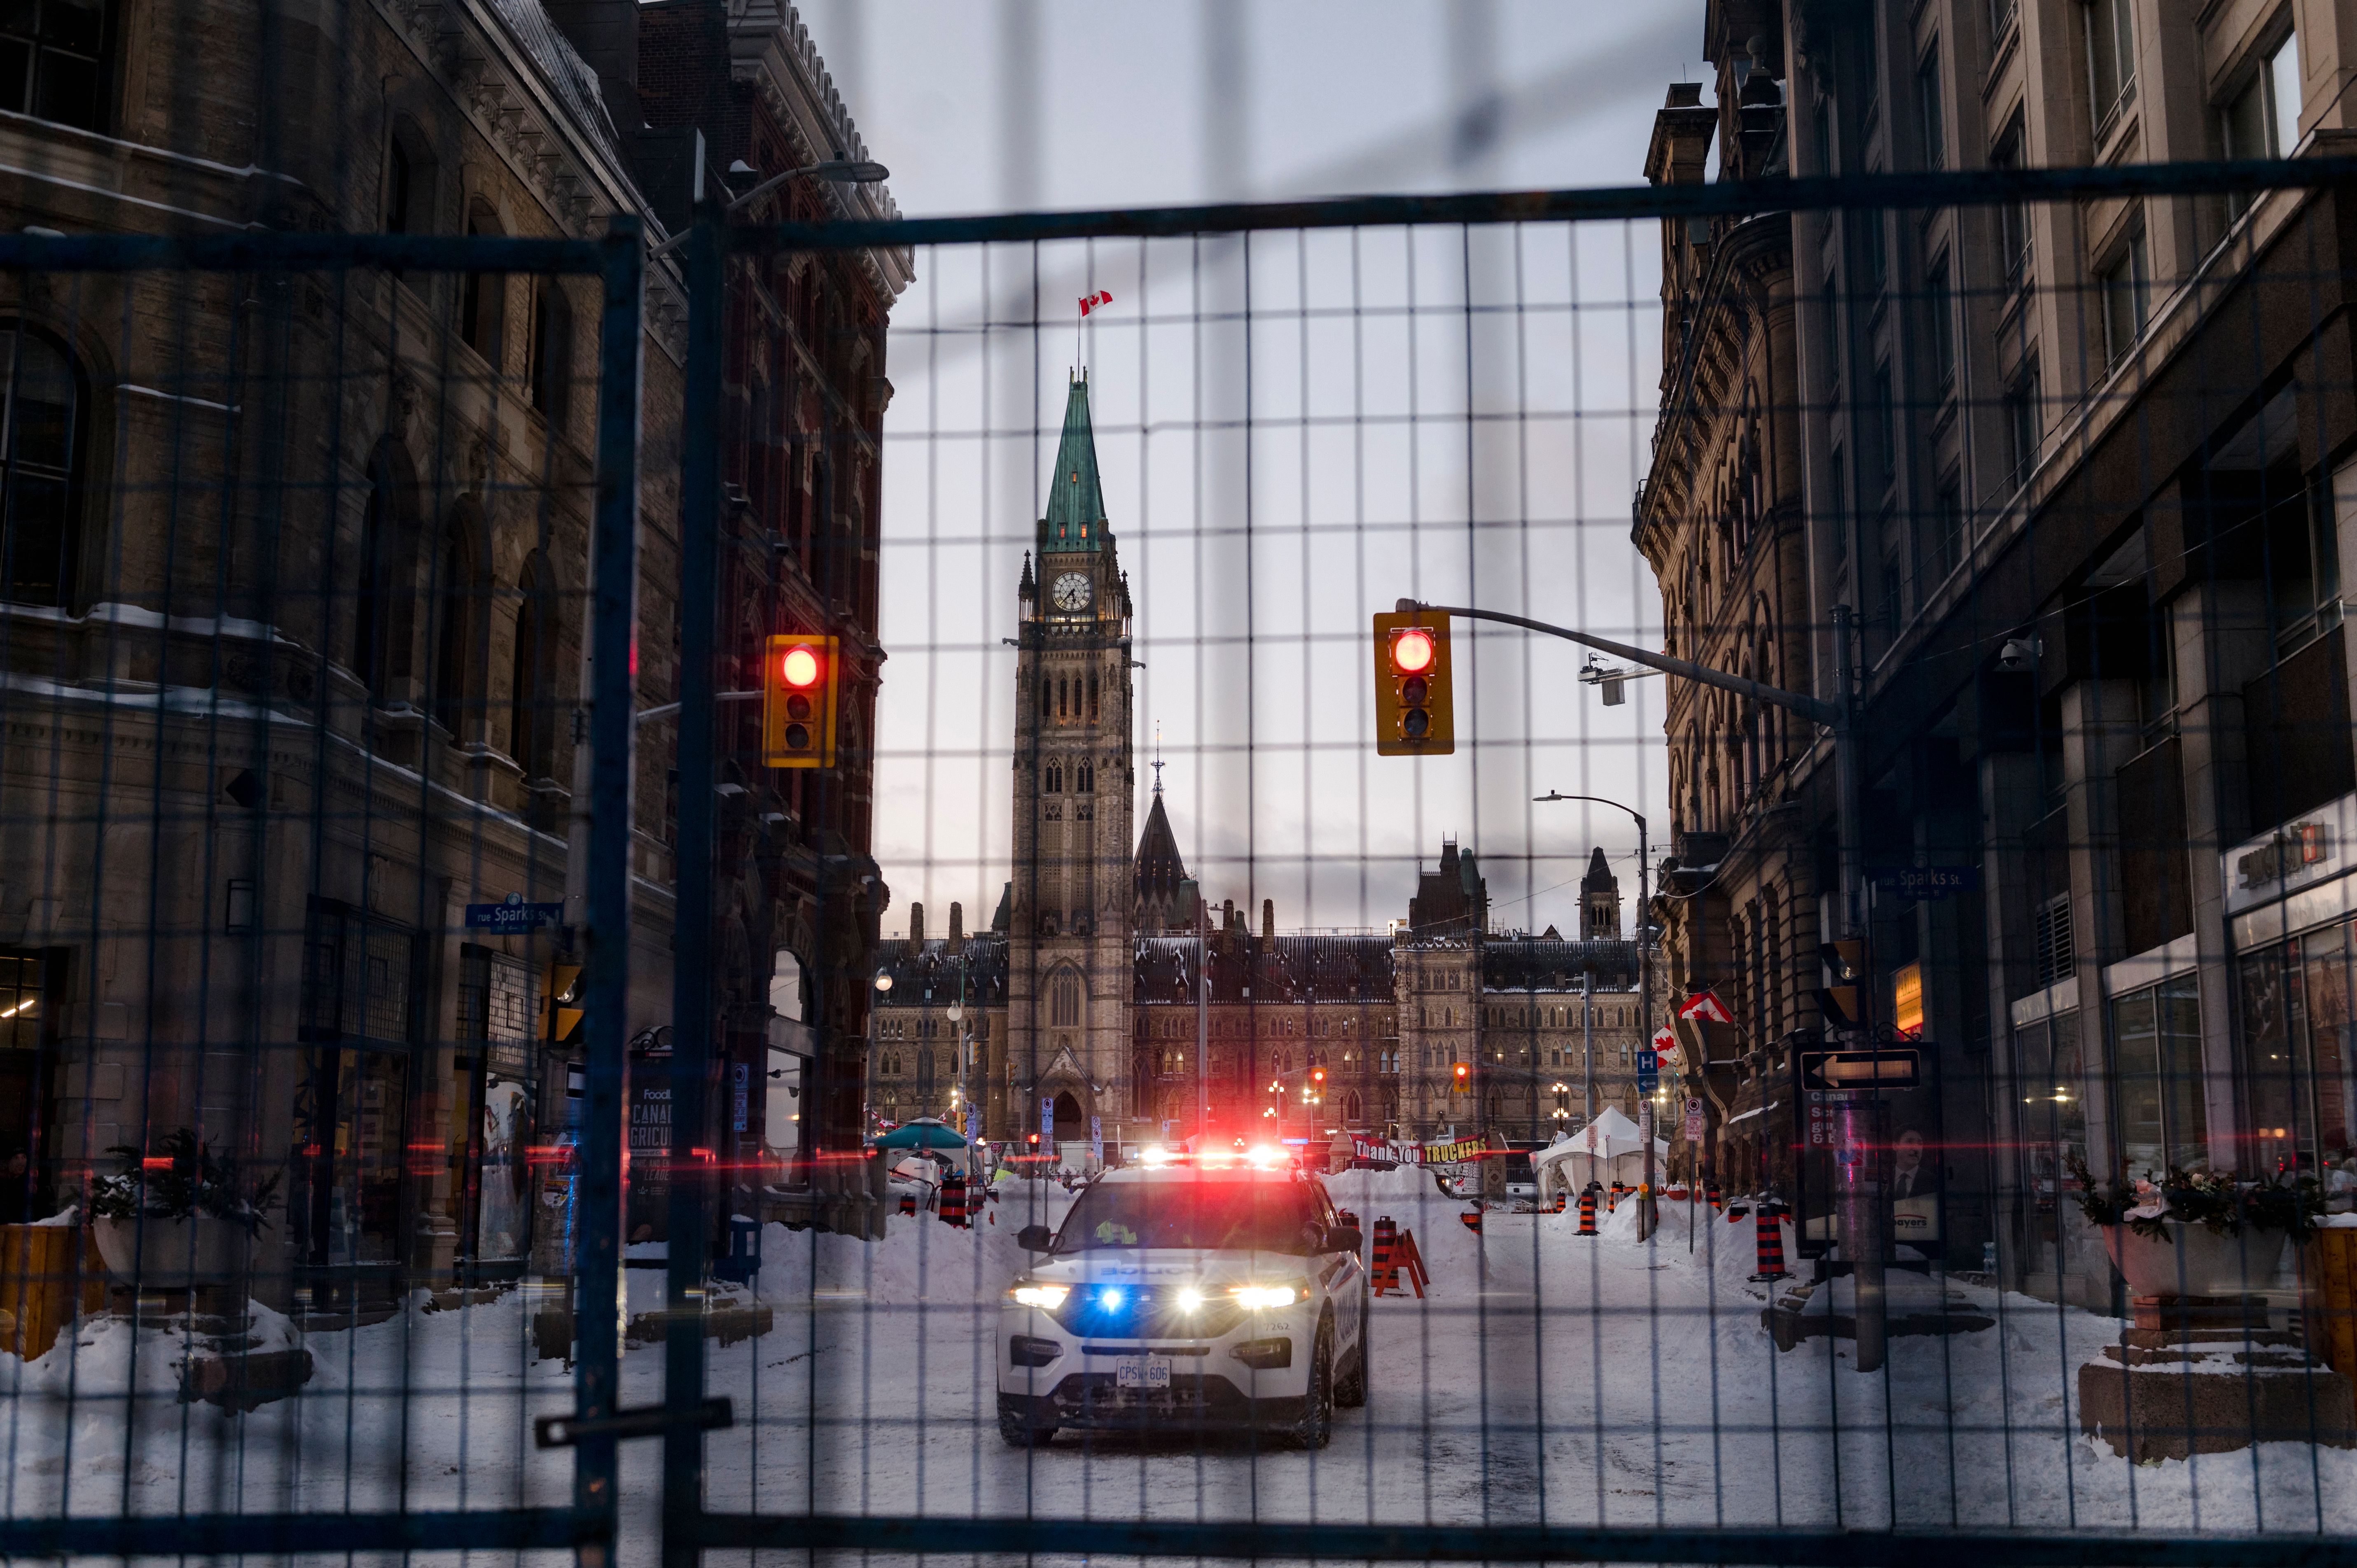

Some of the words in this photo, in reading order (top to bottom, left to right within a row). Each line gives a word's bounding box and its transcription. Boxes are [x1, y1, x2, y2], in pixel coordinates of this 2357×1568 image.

[1880, 877, 1895, 886] rue
[1899, 868, 1946, 890] Sparks
[1950, 874, 1962, 885] St.
[478, 914, 491, 922] rue
[494, 905, 534, 925] Sparks
[1641, 1056, 1654, 1069] H
[1356, 1140, 1394, 1161] Thank
[1397, 1146, 1420, 1162] You
[1425, 1138, 1486, 1162] TRUCKERS
[644, 1169, 670, 1181] LEADE
[1119, 1366, 1144, 1380] CPSW
[1149, 1366, 1167, 1380] 606
